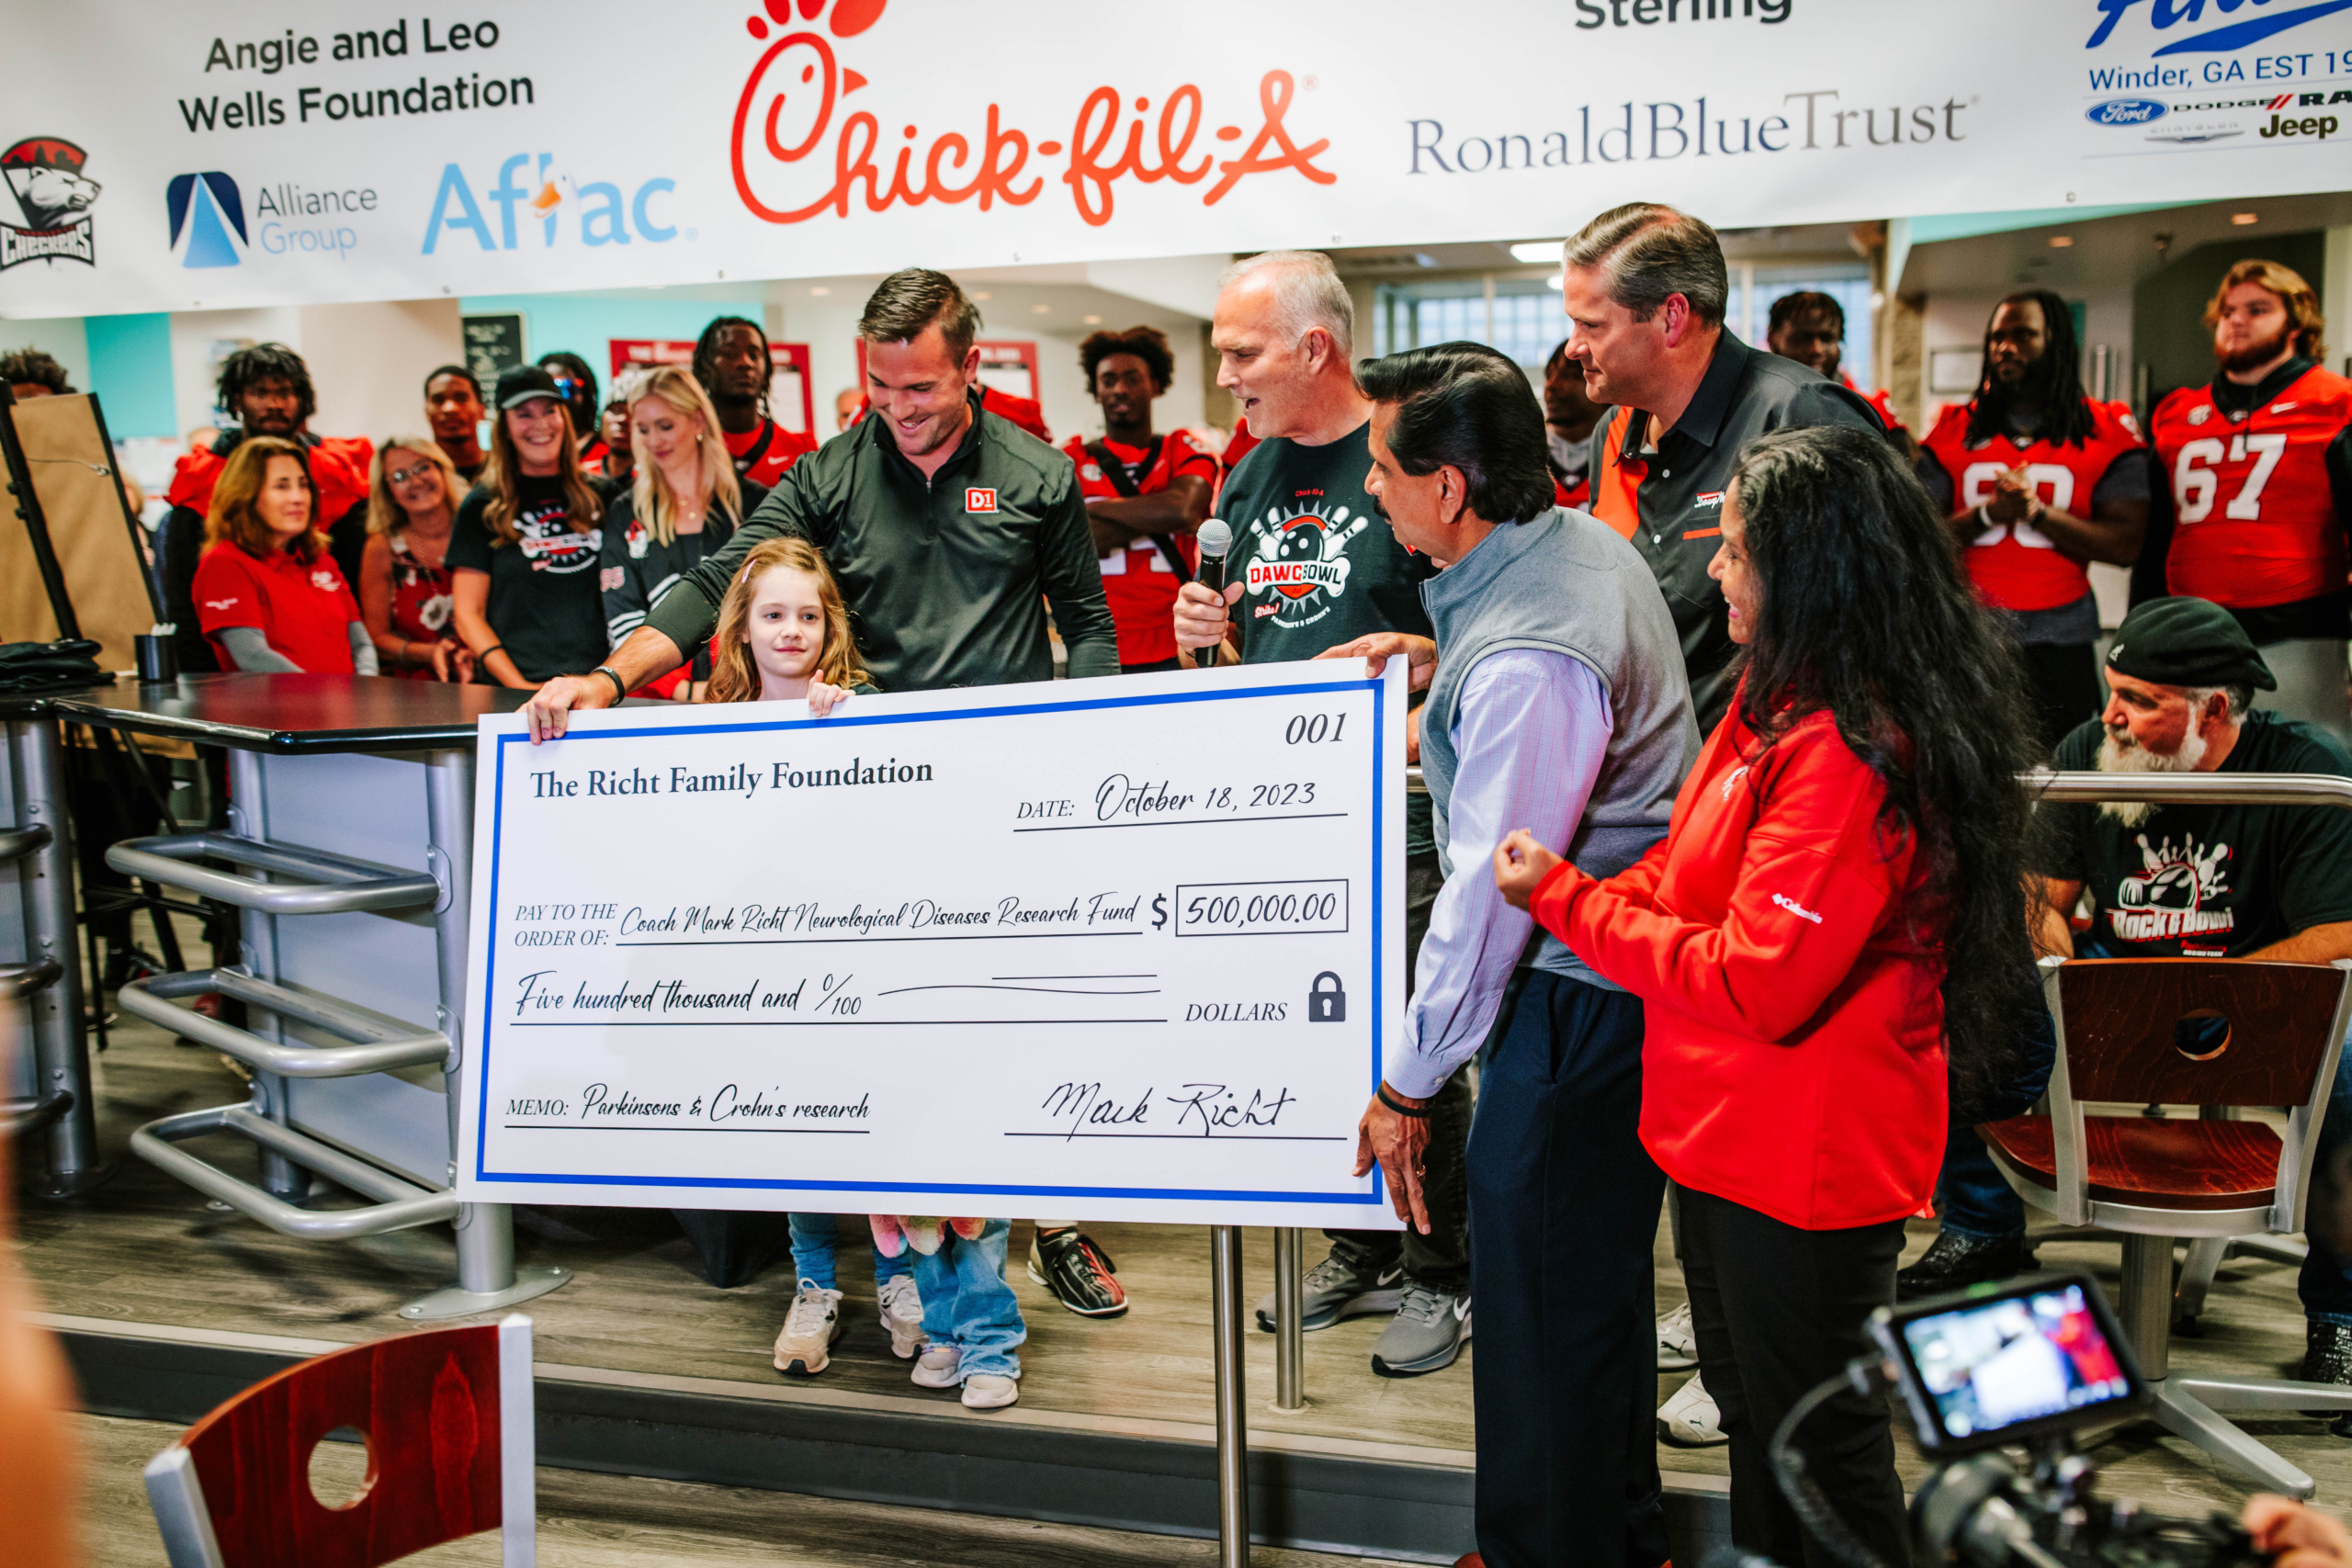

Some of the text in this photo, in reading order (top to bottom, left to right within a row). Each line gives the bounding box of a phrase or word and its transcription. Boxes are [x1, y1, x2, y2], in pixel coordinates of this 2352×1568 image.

[204, 17, 500, 75] Angie and Leo
[2088, 63, 2193, 91] Winder,
[2203, 59, 2245, 85] GA
[2255, 53, 2314, 80] EST
[177, 72, 535, 134] Wells Foundation
[2101, 101, 2153, 123] Ford
[2173, 99, 2277, 112] DODGE
[729, 31, 1338, 227] Chick-fil-A
[2259, 114, 2338, 140] Jeep
[256, 183, 379, 219] Alliance
[420, 152, 680, 257] Aflac
[0, 219, 93, 267] CHECKERS
[260, 222, 358, 261] Group
[2174, 433, 2288, 525] 67
[970, 491, 993, 508] D1
[1285, 712, 1347, 745] 001
[529, 757, 933, 799] The Richt Family Foundation
[1016, 773, 1316, 822] DATE: October 18, 2023
[514, 903, 618, 921] PAY TO THE
[620, 891, 1142, 936] Coach Mark Richt Neurological Diseases Research Fund
[1151, 892, 1338, 931] $ 500,000.00
[514, 930, 610, 947] ORDER OF:
[516, 970, 566, 1016] Five
[572, 980, 661, 1012] hundred
[659, 978, 760, 1013] thousand
[762, 977, 807, 1011] and
[1184, 1002, 1288, 1022] DOLLARS
[505, 1082, 871, 1122] MEMO: Parkinsons & Crohn's research
[1167, 1083, 1296, 1137] Richt
